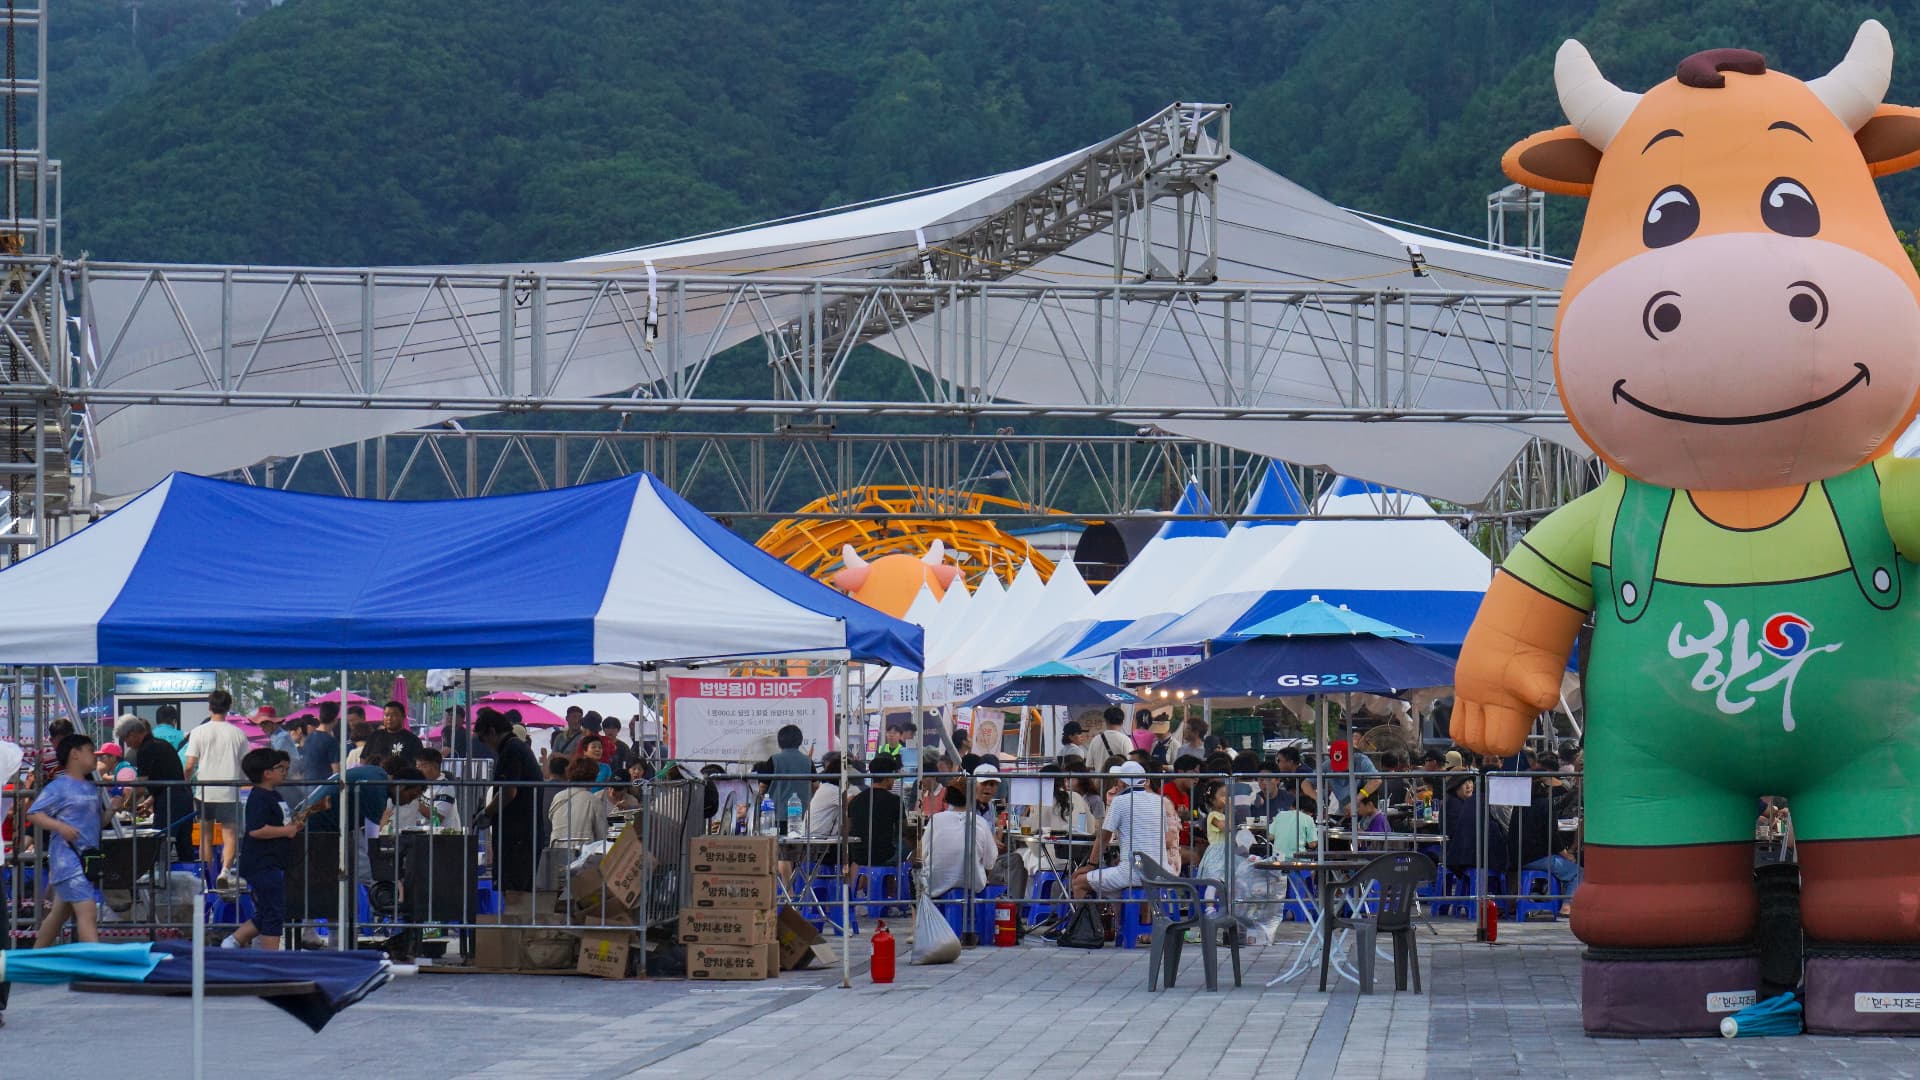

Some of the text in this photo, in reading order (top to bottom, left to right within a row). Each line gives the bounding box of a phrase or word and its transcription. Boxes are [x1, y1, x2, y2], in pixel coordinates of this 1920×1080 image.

[1667, 599, 1844, 733] 한우
[1277, 673, 1360, 687] GS25
[994, 696, 1027, 704] GS25
